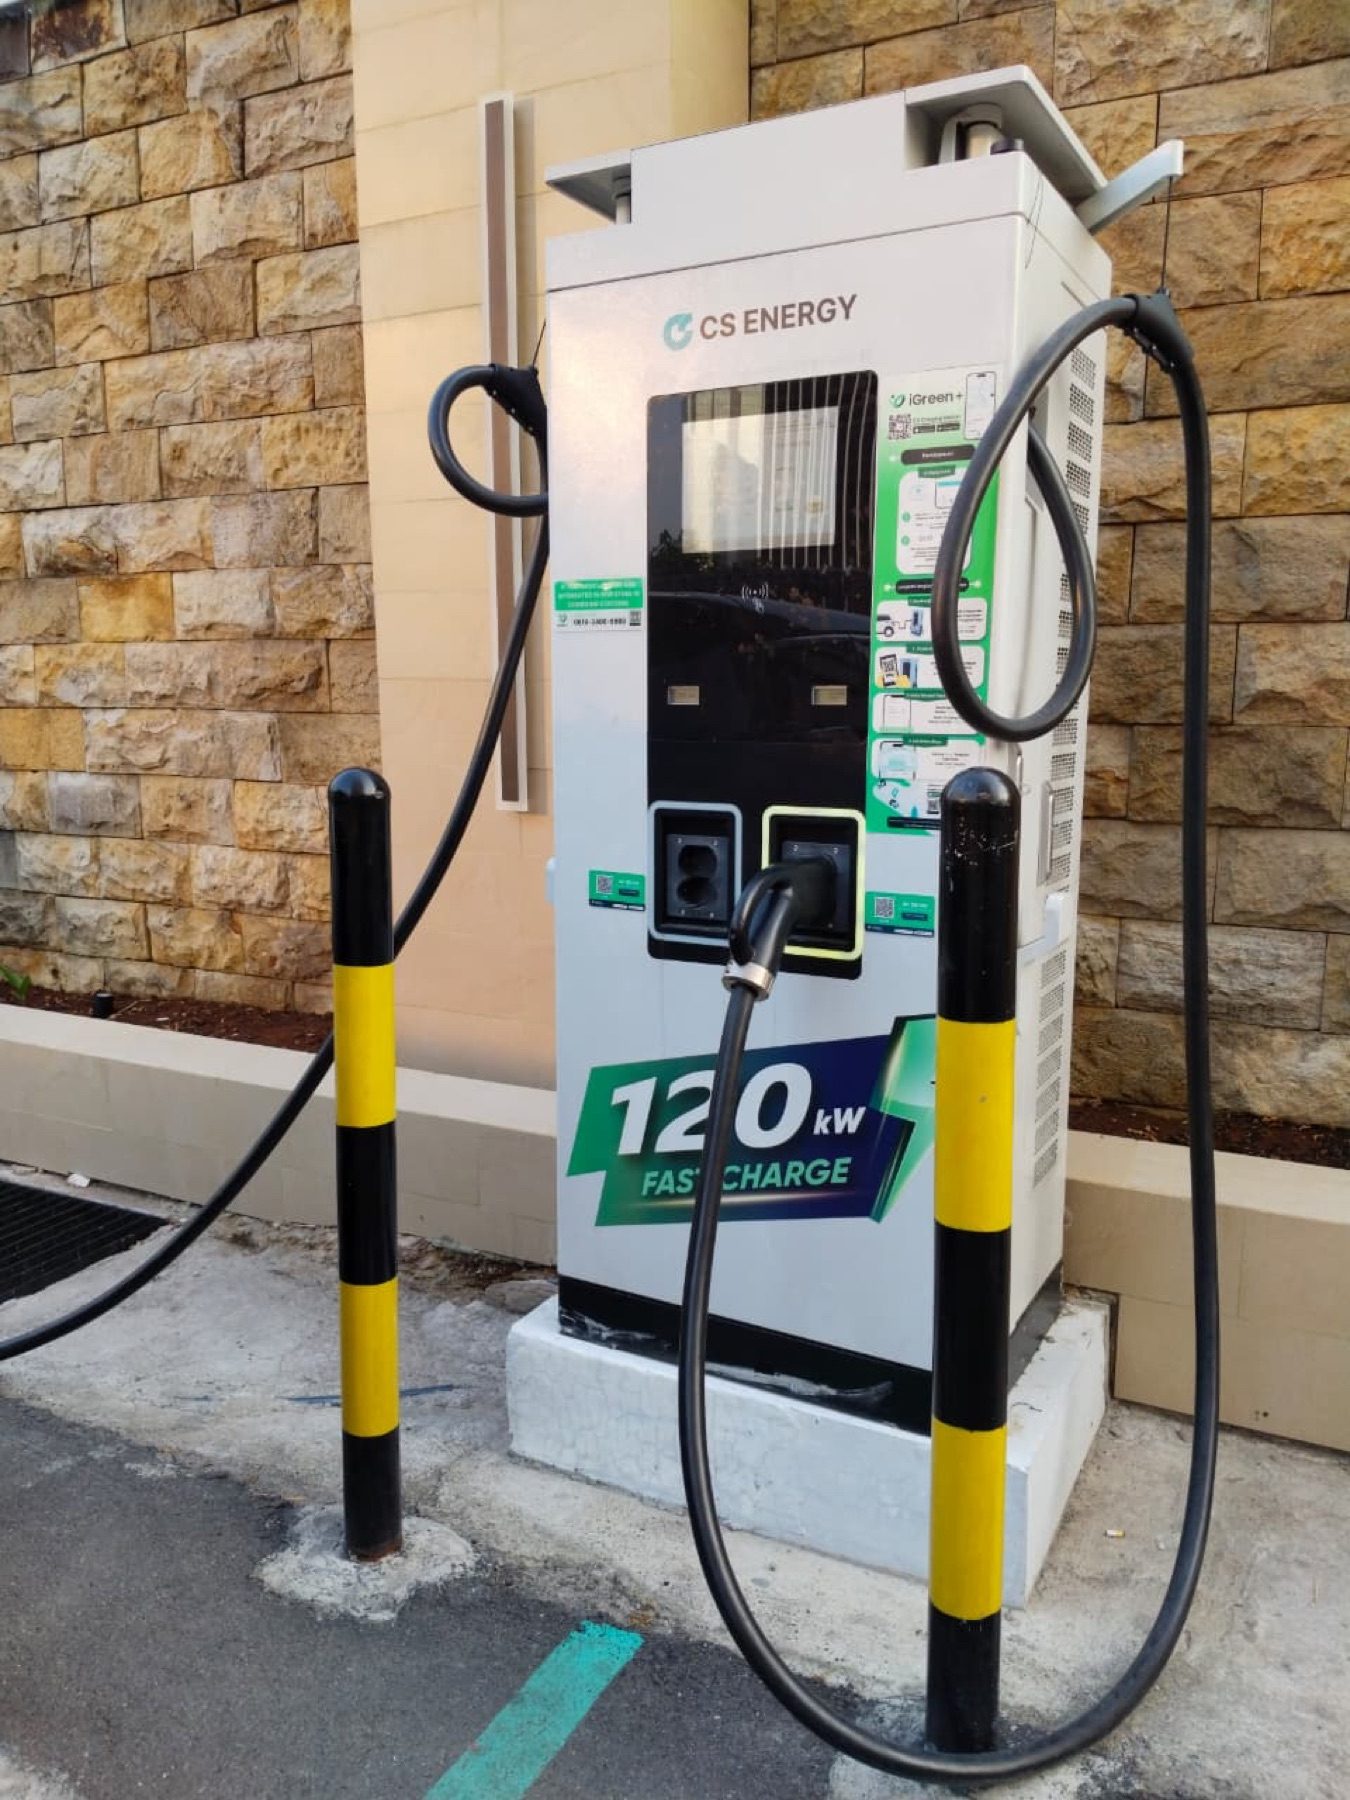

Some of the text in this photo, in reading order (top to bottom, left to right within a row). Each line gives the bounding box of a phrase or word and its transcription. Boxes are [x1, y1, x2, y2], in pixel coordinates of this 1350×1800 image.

[699, 294, 858, 340] CS ENERGY
[611, 1063, 866, 1155] 120 kW
[641, 1157, 852, 1197] FAS CHARGE
